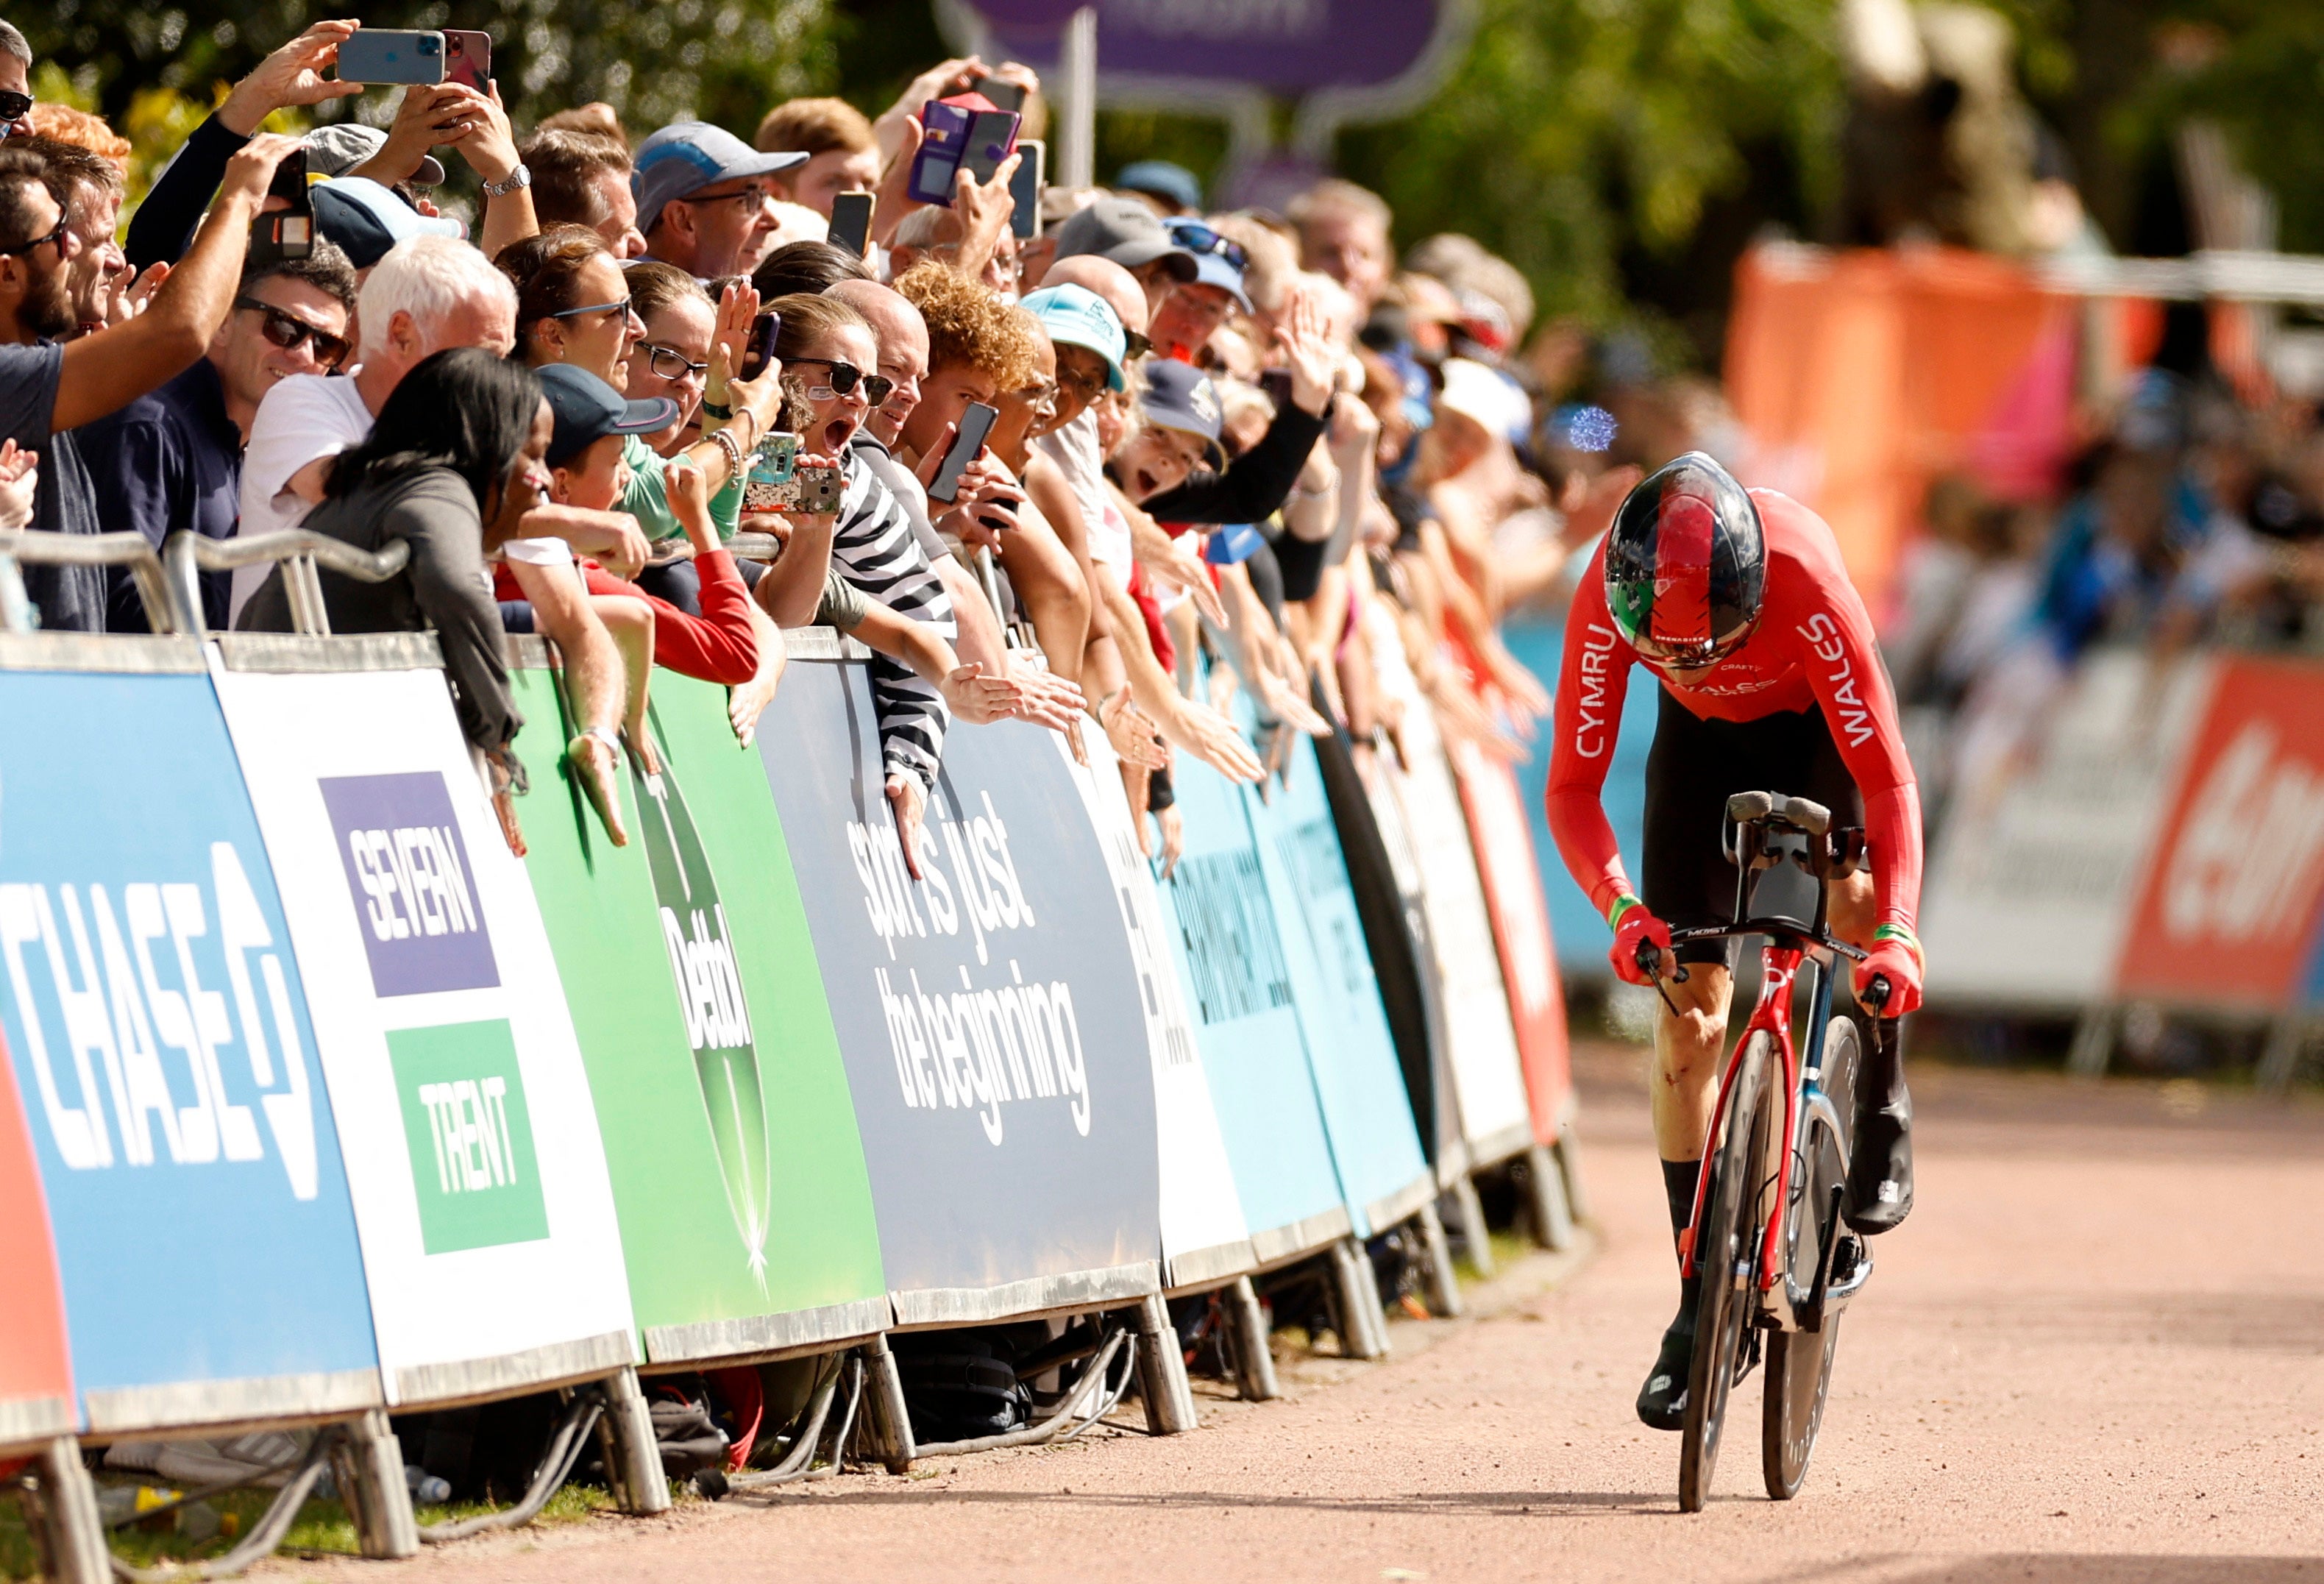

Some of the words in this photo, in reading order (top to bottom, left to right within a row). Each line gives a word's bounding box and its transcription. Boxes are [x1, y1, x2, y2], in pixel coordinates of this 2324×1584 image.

[1577, 623, 1617, 759] CYMRU
[1796, 613, 1875, 749] WALES
[349, 825, 477, 942] SEVERN
[931, 789, 1035, 966] just
[0, 883, 264, 1169] CHASE
[660, 903, 752, 1050] Dettol
[874, 967, 937, 1109] the
[909, 958, 1091, 1146] beginning
[419, 1076, 516, 1195] TRENT
